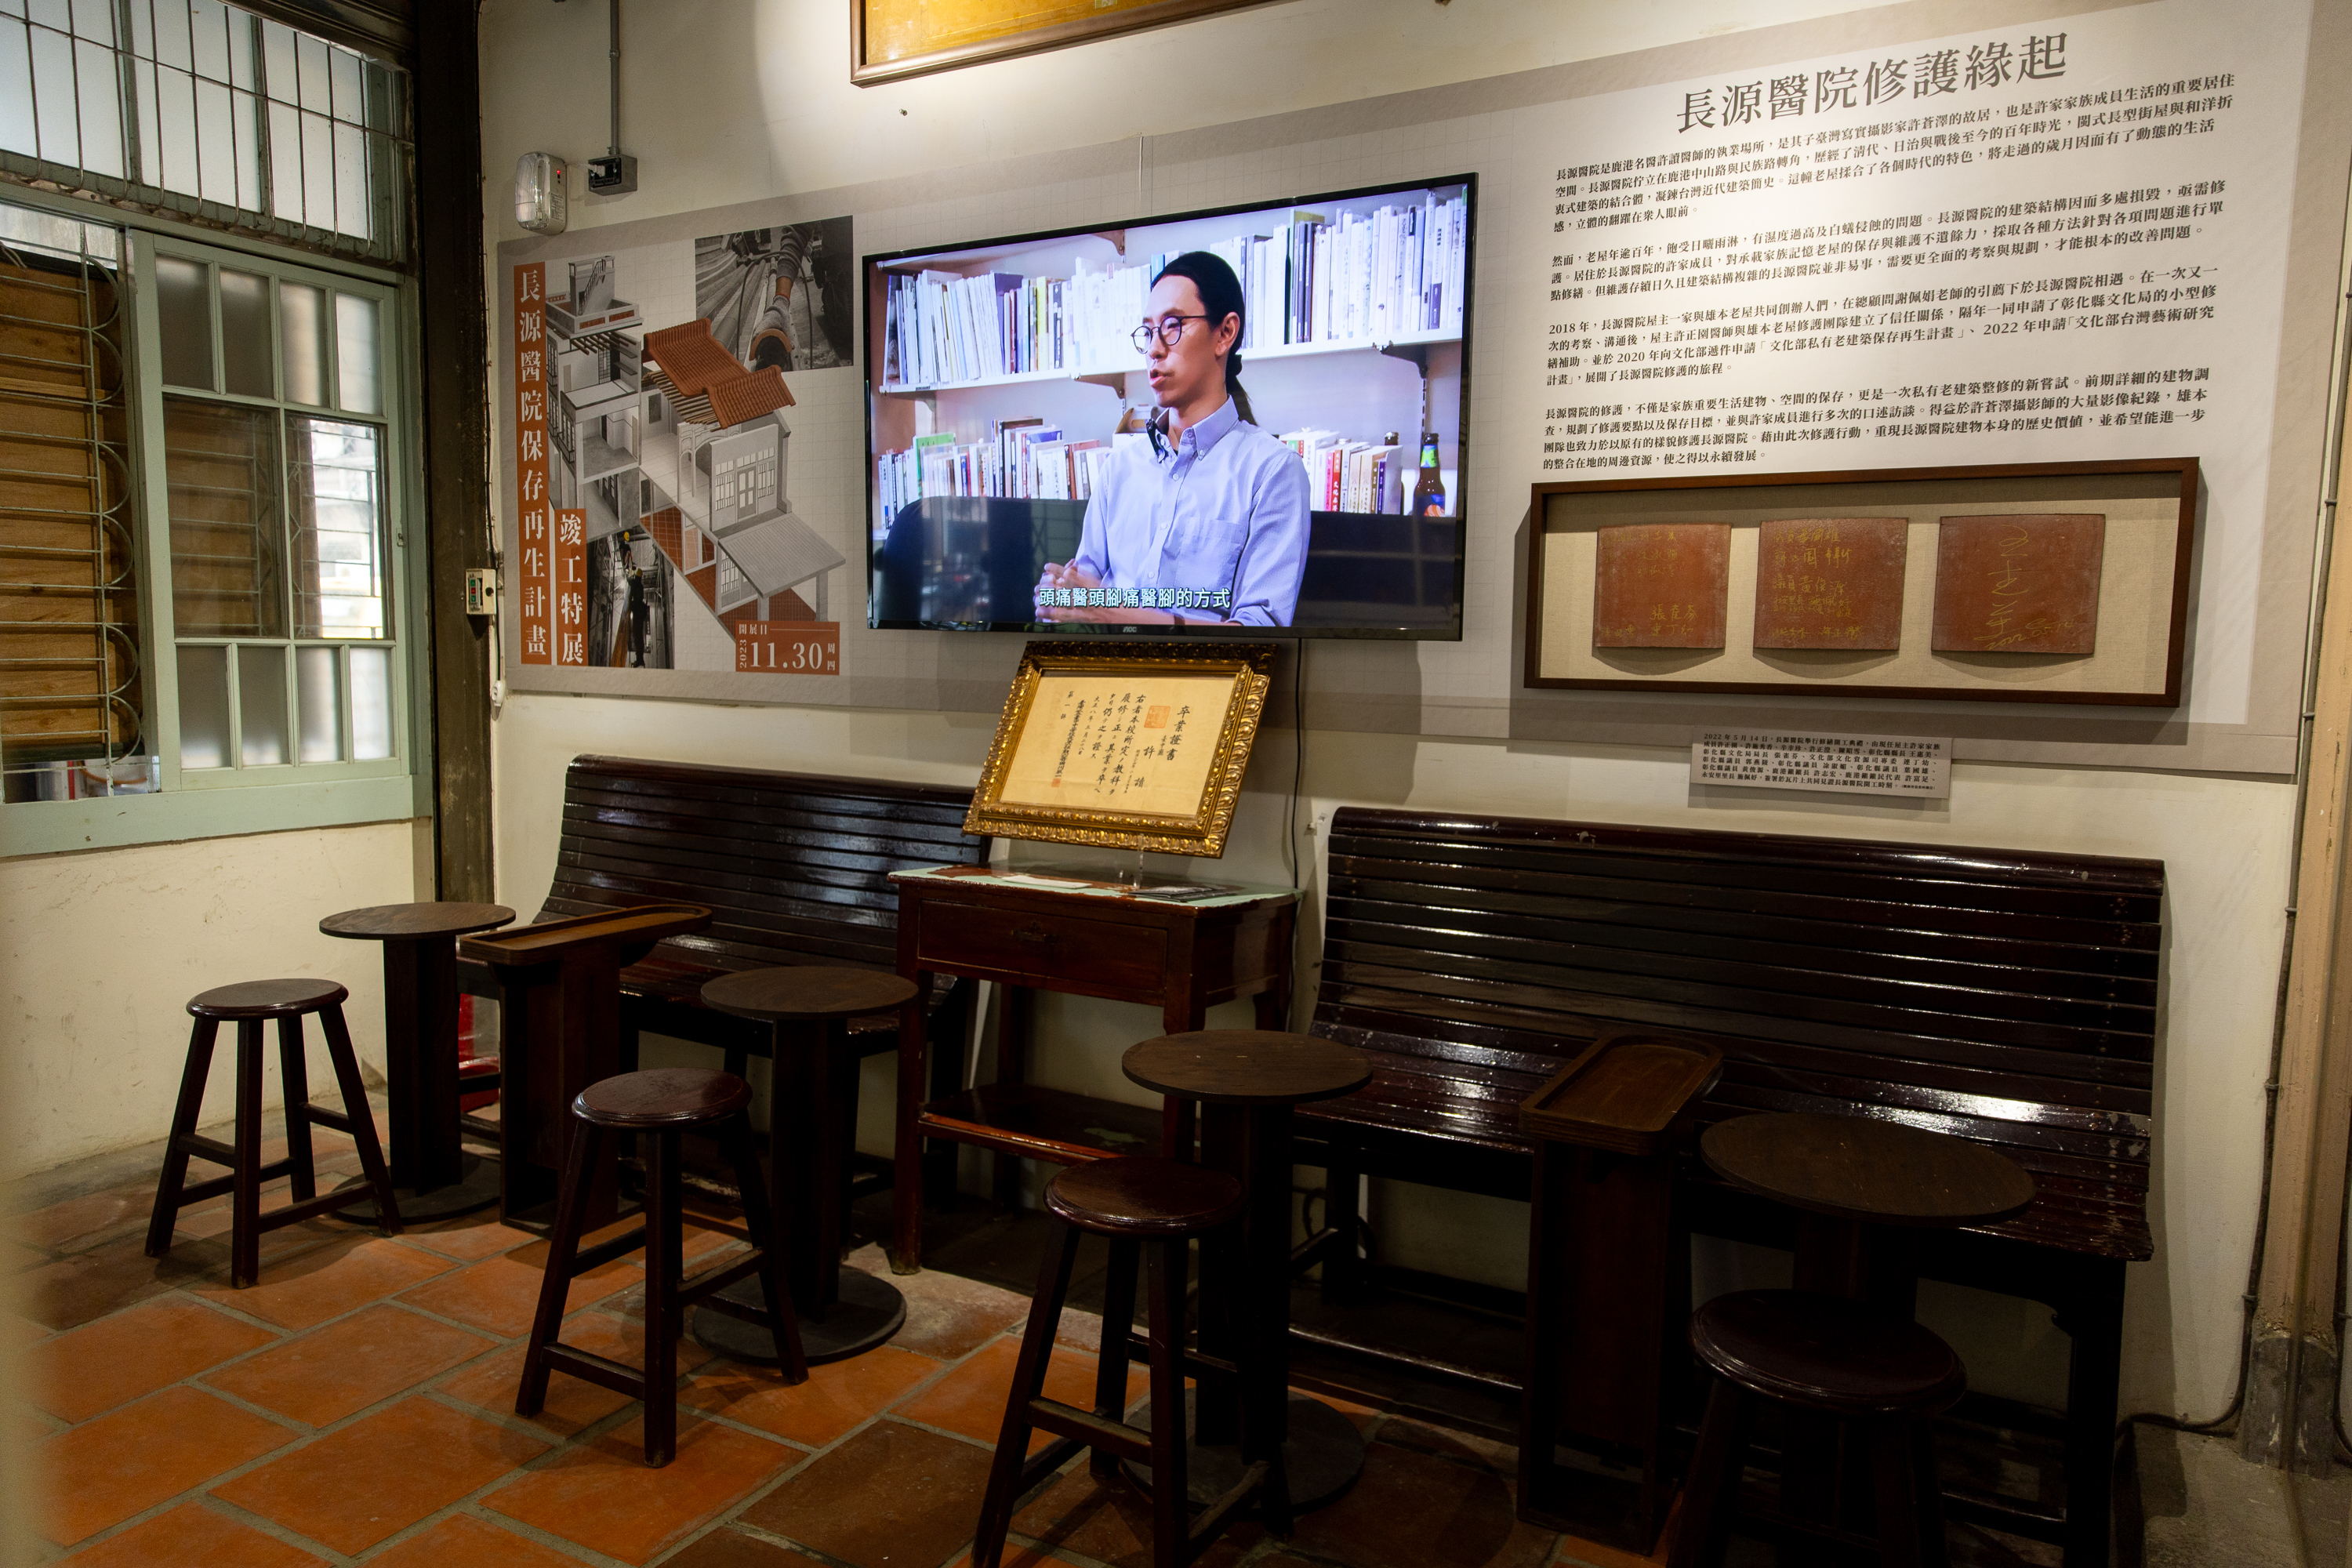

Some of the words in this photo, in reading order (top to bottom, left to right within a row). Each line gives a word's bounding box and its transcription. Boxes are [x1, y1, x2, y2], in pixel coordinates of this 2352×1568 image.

[1676, 32, 2067, 134] 長源醫院修護緣起
[1549, 323, 1575, 334] 2018
[1617, 352, 1645, 363] 2020
[1984, 322, 2018, 335] 2022
[519, 269, 547, 655] 長源醫院保存再生計畫
[559, 514, 583, 664] 竣工特展
[1039, 587, 1232, 609] 頭痛醫頭腳痛醫腳的方式
[739, 623, 768, 636] 開展日
[750, 641, 822, 670] 11.30
[827, 643, 836, 671] 周四
